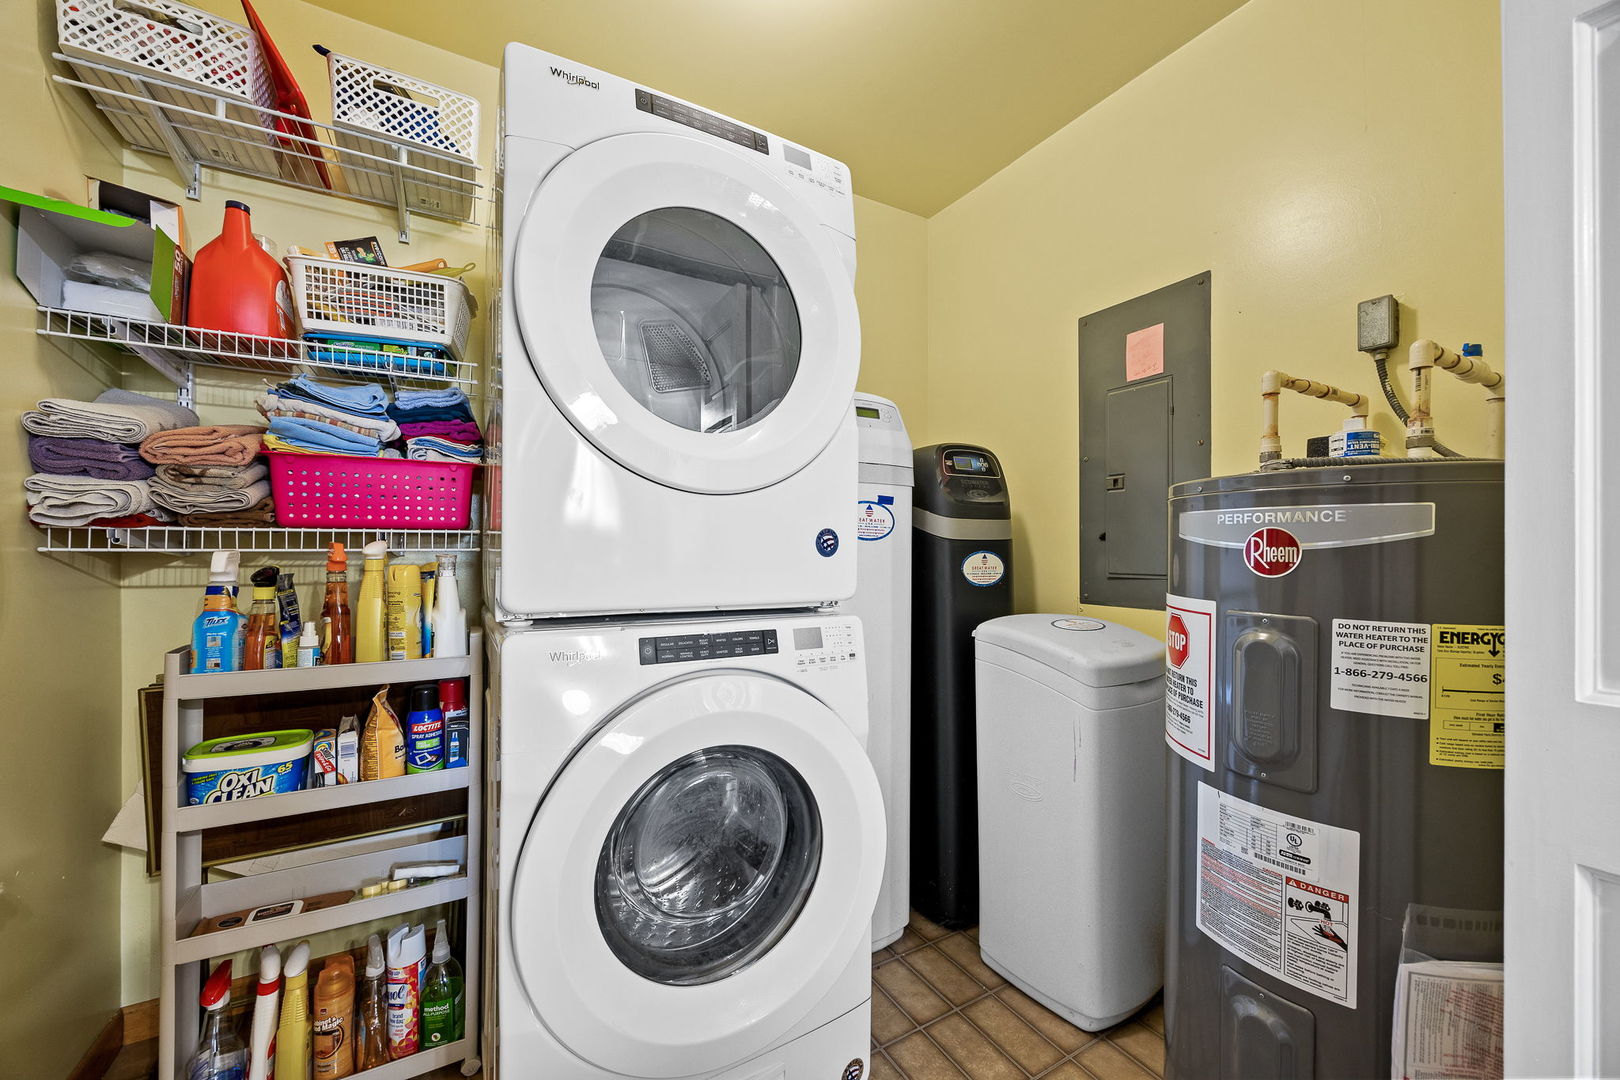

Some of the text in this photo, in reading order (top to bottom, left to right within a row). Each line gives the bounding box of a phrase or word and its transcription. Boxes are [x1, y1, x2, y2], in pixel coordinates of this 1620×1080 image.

[550, 66, 600, 90] Whirlpool
[1217, 509, 1347, 525] PERFORMANCE
[1249, 529, 1299, 569] Rheem
[1335, 632, 1364, 640] WATER
[1365, 634, 1398, 642] HEATER
[1372, 625, 1406, 634] RETURN
[1407, 627, 1427, 635] THIS
[1338, 641, 1365, 649] PLACE
[1379, 644, 1425, 653] PURCHASE
[1440, 631, 1505, 648] ENERGYG
[1333, 667, 1428, 683] 1-866-279-4566
[1178, 691, 1204, 709] PURCHASE
[413, 721, 442, 733] LOCTITE
[277, 761, 293, 775] 65
[220, 768, 260, 793] OXI
[206, 775, 276, 804] CLEAN
[1301, 882, 1345, 901] DANGER
[388, 985, 405, 1001] sol
[423, 1003, 449, 1012] method
